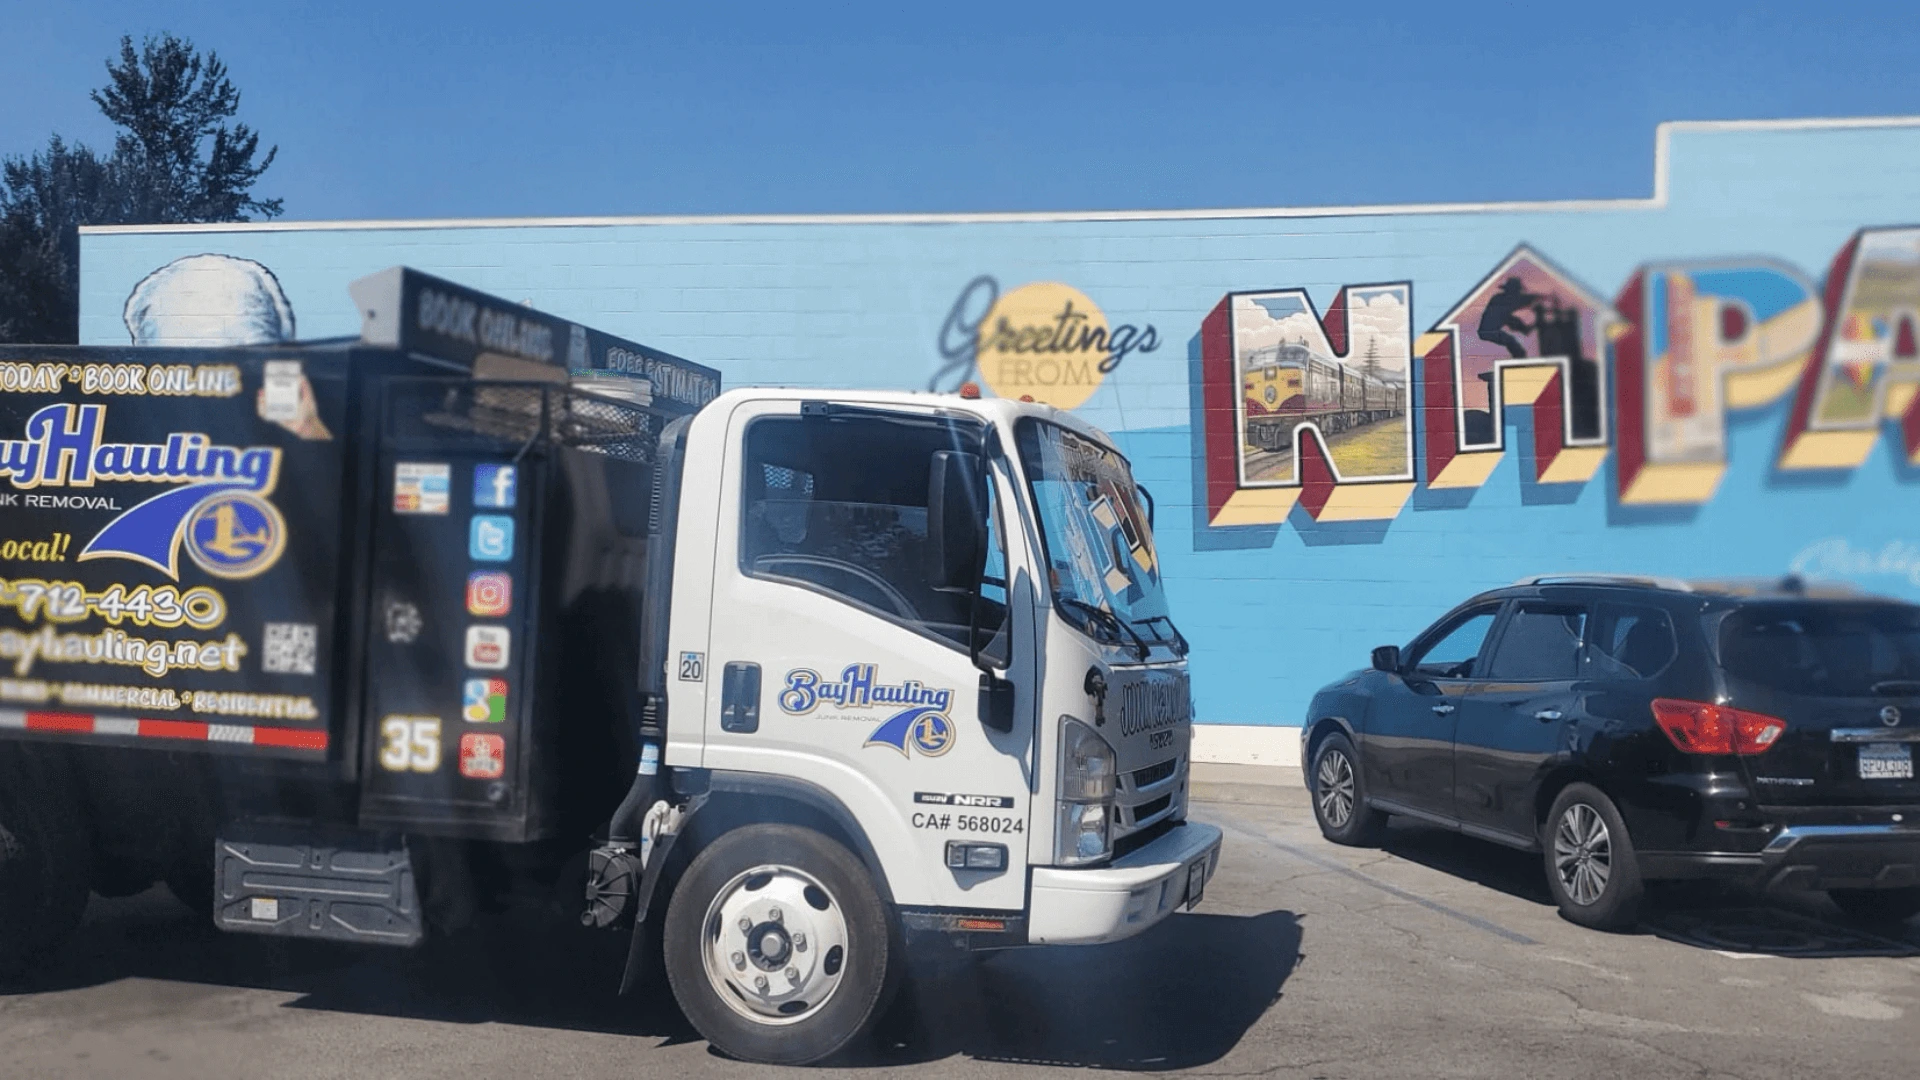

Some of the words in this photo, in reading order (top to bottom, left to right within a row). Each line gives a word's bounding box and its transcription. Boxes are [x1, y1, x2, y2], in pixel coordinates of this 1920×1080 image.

[928, 274, 1161, 392] Greetings
[82, 364, 147, 395] BOOK
[148, 364, 242, 397] ONLINE
[997, 358, 1096, 387] FROM
[25, 494, 122, 511] REMOVAL
[0, 532, 71, 562] ocal!
[0, 577, 227, 630] -712-4430
[682, 660, 701, 679] 20
[62, 682, 181, 710] COMMERCIAL
[191, 690, 319, 720] RESIDENTIAL
[841, 714, 881, 723] REMOVAL
[380, 714, 442, 773] 35
[953, 795, 1002, 808] NRR
[911, 812, 951, 831] CA#
[957, 814, 1025, 834] 568024
